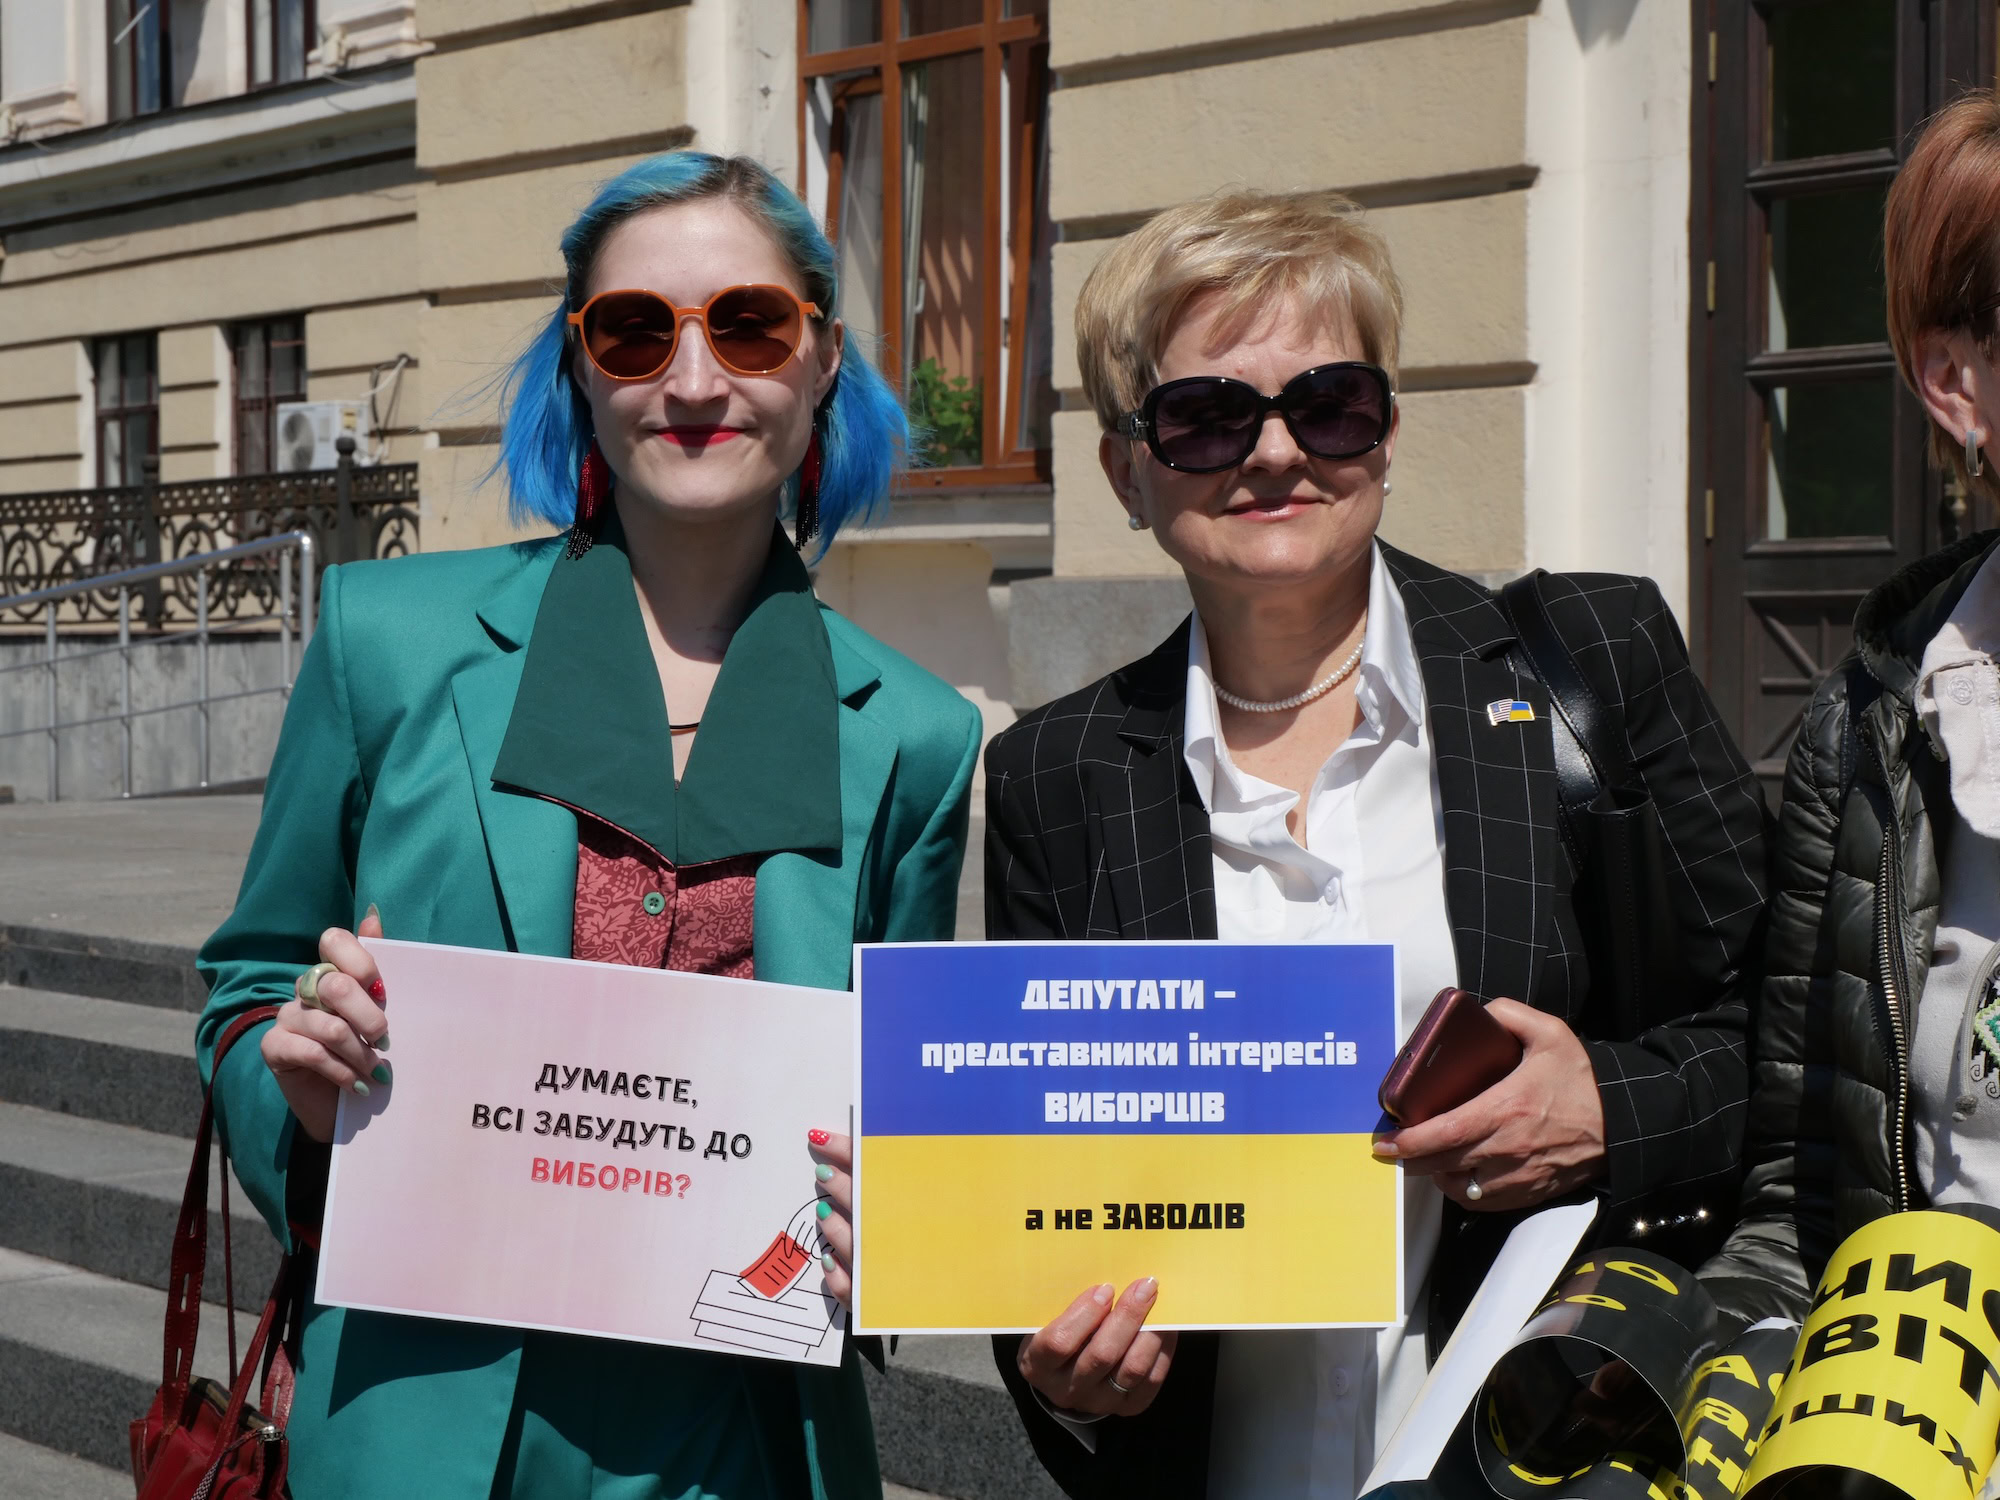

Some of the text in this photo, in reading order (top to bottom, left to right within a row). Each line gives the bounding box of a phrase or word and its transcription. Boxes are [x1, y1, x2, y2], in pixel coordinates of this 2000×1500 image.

[1021, 979, 1205, 1010] ДЕПУТАТИ
[921, 1031, 1358, 1074] представники інтересів
[534, 1063, 698, 1109] ДУМАЄТЕ,
[1044, 1091, 1225, 1123] ВИБОРЦІВ
[471, 1103, 753, 1161] ВСІ ЗАБУДУТЬ ДО
[530, 1157, 693, 1199] ВИБОРІВ?
[1025, 1202, 1245, 1231] а не ЗАВОДІВ
